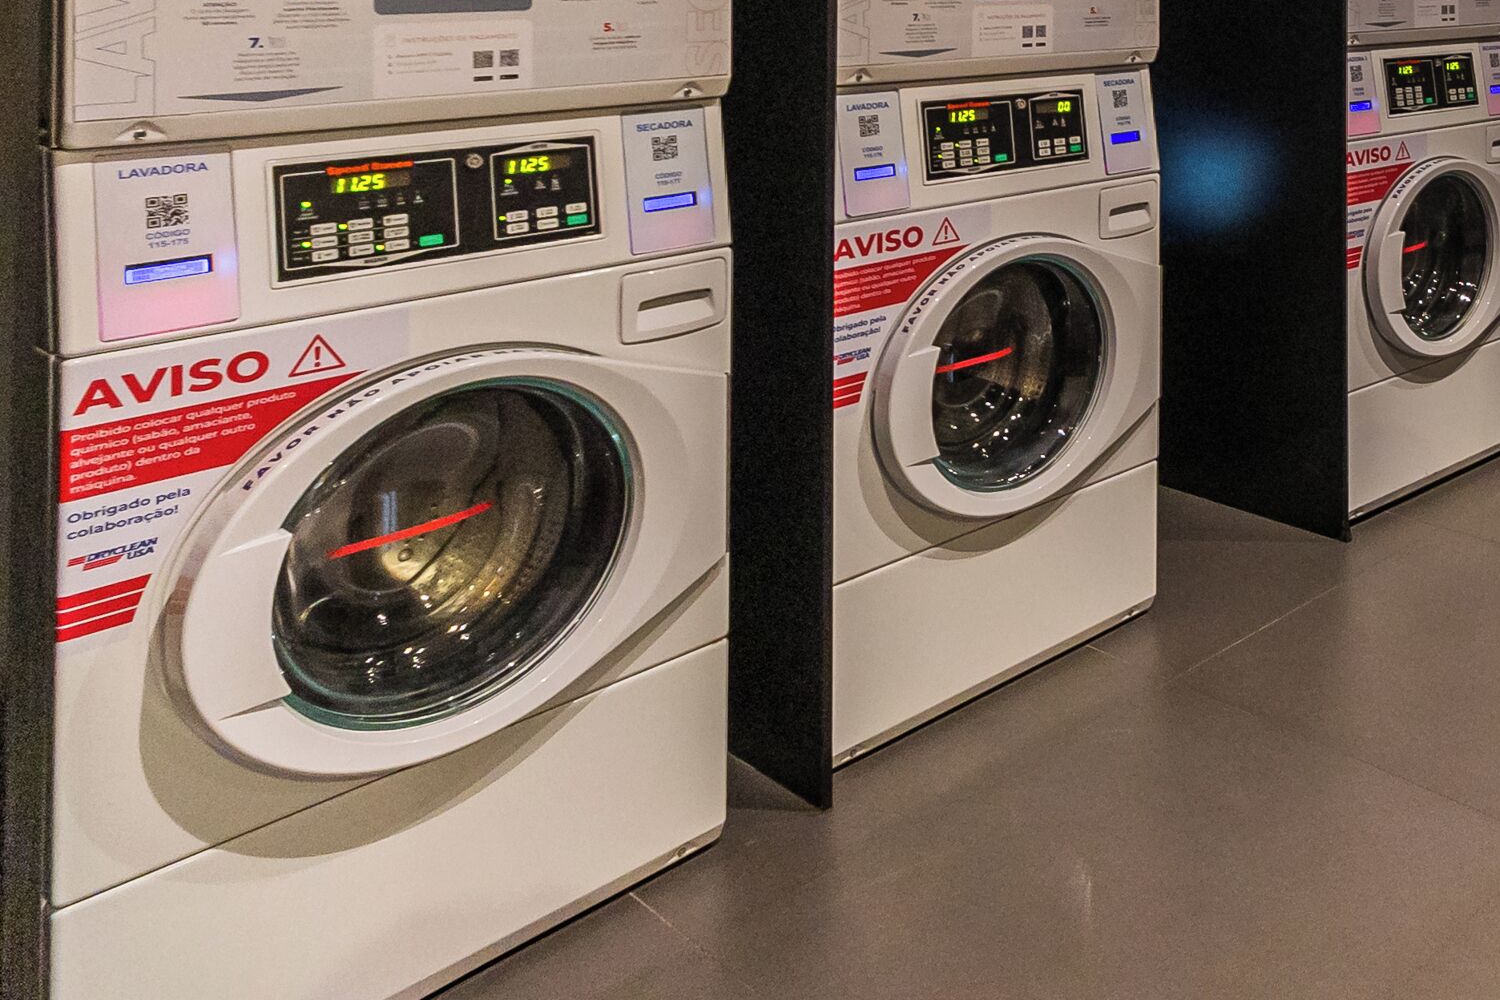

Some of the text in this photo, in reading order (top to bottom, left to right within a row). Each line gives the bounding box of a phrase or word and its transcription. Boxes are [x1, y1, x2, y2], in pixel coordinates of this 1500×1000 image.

[248, 37, 264, 48] 7.
[1103, 78, 1135, 87] SECADORA
[846, 102, 889, 112] LAVADORA
[636, 120, 693, 132] SECADORA
[1346, 146, 1391, 166] AVISO
[118, 162, 208, 179] LAVADORA
[834, 226, 924, 262] AVISO
[901, 289, 938, 333] FAVOR
[938, 263, 966, 285] NÃO
[870, 315, 886, 325] pela
[73, 350, 270, 416] AVISO
[70, 391, 296, 443] Proibido colocar qualquer produto
[242, 425, 321, 491] FAVOR
[327, 386, 381, 420] NÃO
[392, 354, 484, 385] APOIAR
[70, 423, 255, 469] alvejante ou qualquer outro
[70, 438, 129, 457] químico
[70, 446, 201, 483] produto) dentro da
[67, 487, 191, 525] Obrigado pela
[67, 505, 179, 541] colaboração!
[86, 537, 158, 563] DRYCLEAN
[126, 546, 154, 560] USA
